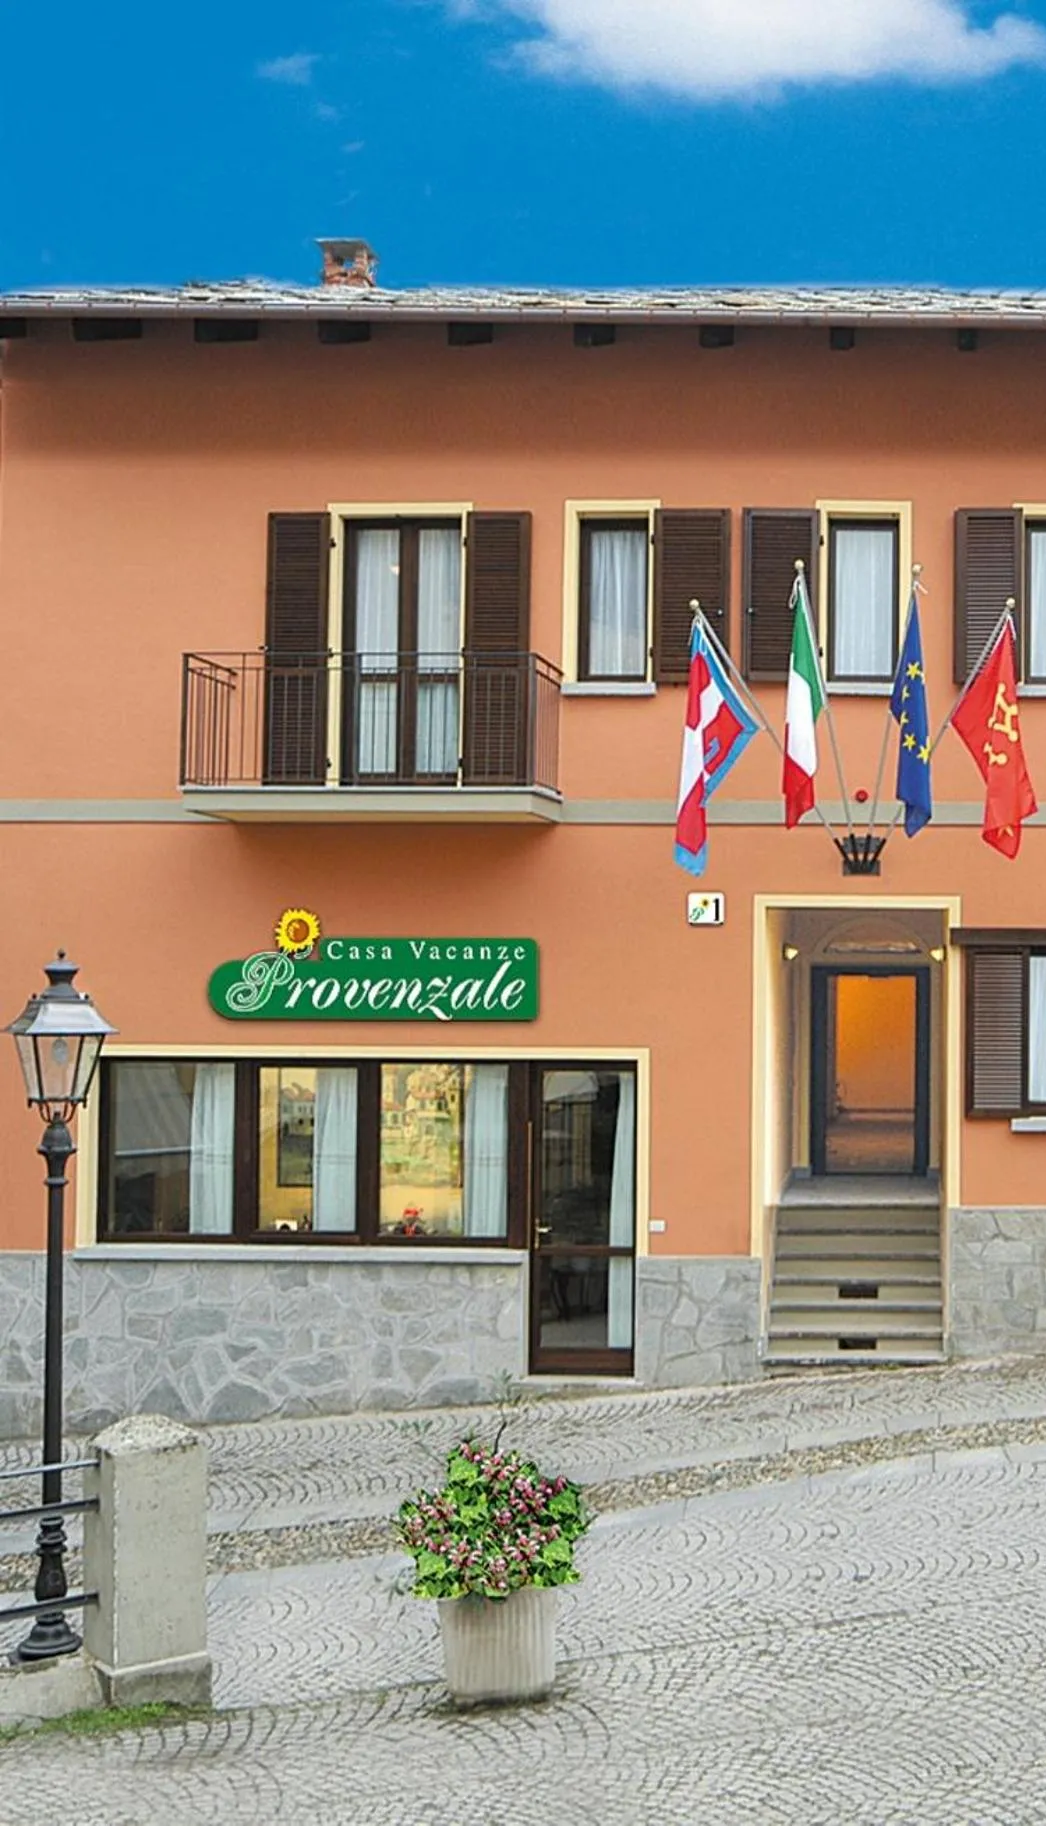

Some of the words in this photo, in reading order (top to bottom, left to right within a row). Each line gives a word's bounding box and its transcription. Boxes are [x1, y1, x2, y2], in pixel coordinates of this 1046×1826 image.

[712, 898, 720, 921] 1
[327, 941, 392, 960] Casa
[410, 941, 526, 960] Vacanze
[225, 950, 527, 1020] Provenzale
